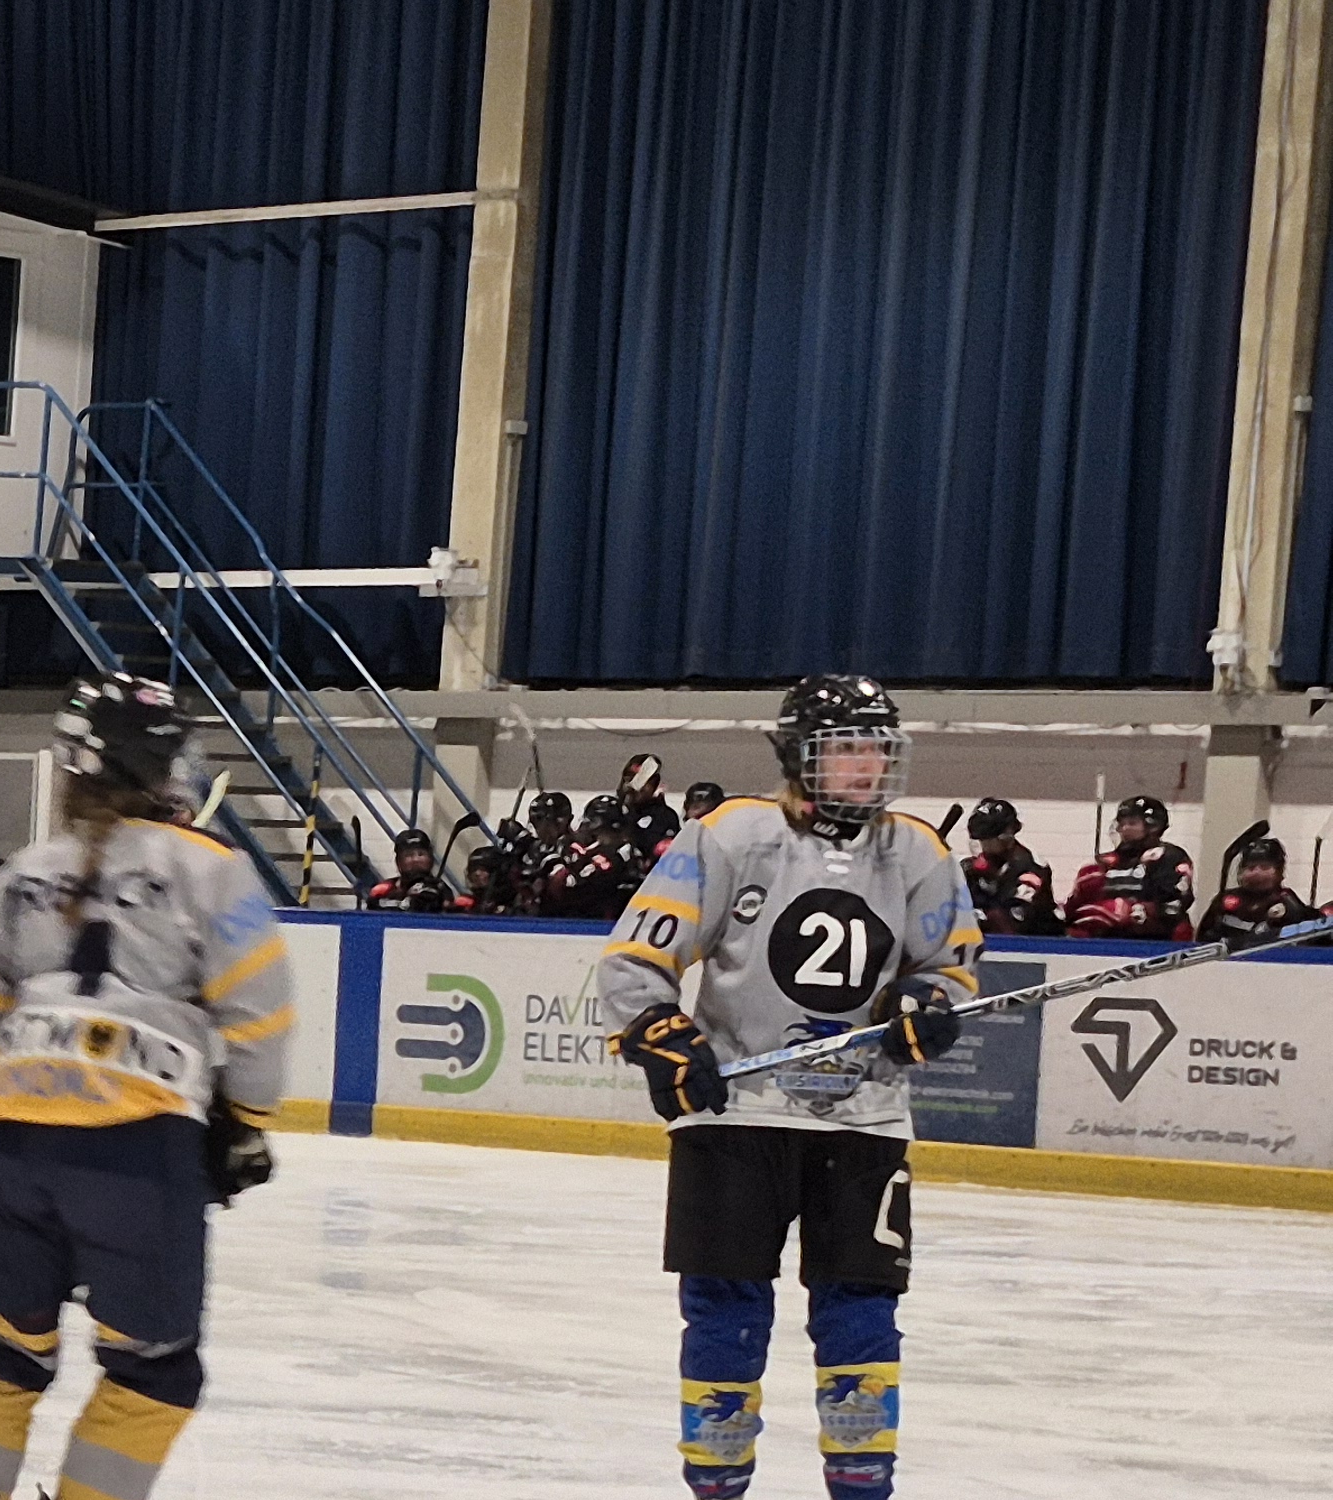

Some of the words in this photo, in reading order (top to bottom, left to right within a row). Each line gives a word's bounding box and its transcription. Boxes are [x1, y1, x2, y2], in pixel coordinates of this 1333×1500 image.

[628, 906, 679, 950] 10
[794, 911, 868, 988] 21
[522, 1031, 629, 1066] ELEKT
[1189, 1038, 1275, 1060] DRUCK
[1280, 1042, 1297, 1061] &
[1187, 1065, 1280, 1087] DESIGN
